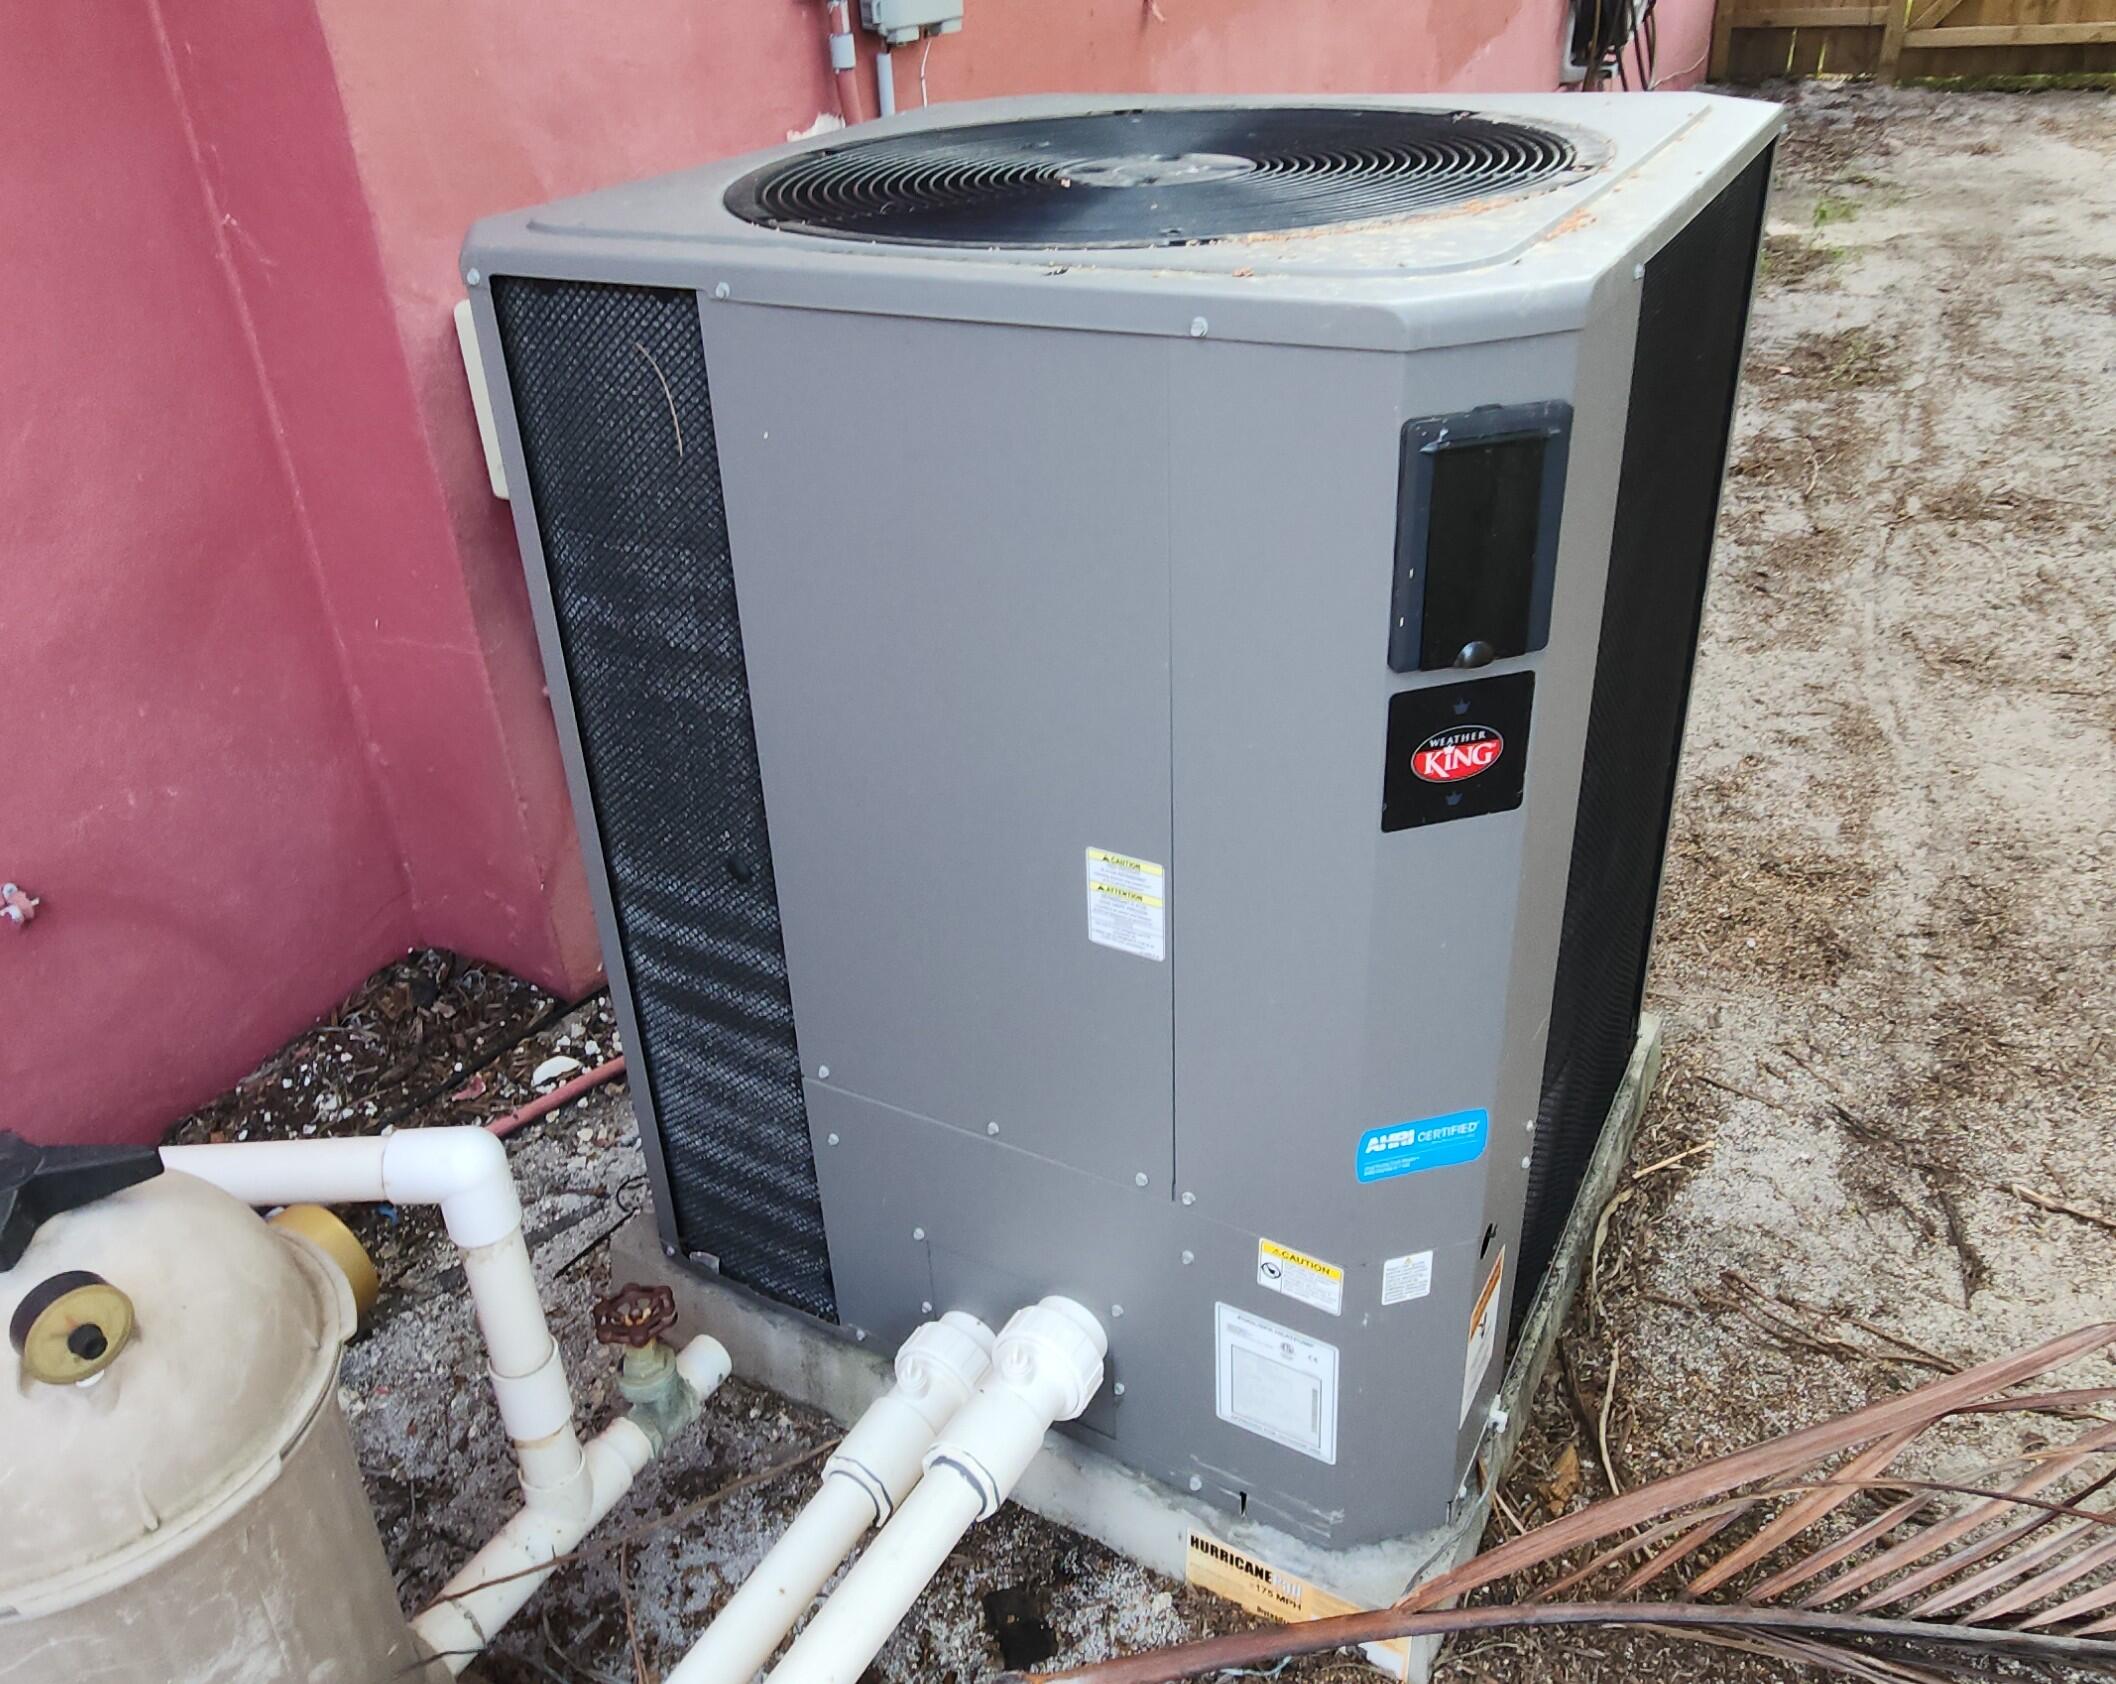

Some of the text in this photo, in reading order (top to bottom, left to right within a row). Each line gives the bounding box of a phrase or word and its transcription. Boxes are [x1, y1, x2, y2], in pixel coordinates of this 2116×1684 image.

[1429, 730, 1487, 748] WEATHER
[1423, 742, 1498, 778] KING
[1110, 856, 1141, 872] CAUTION
[1105, 886, 1143, 902] ATTENTION
[1417, 1121, 1480, 1143] CERTIFIED
[1280, 1250, 1331, 1276] CAUTION
[1255, 1583, 1274, 1599] 175
[1276, 1594, 1303, 1612] MPH
